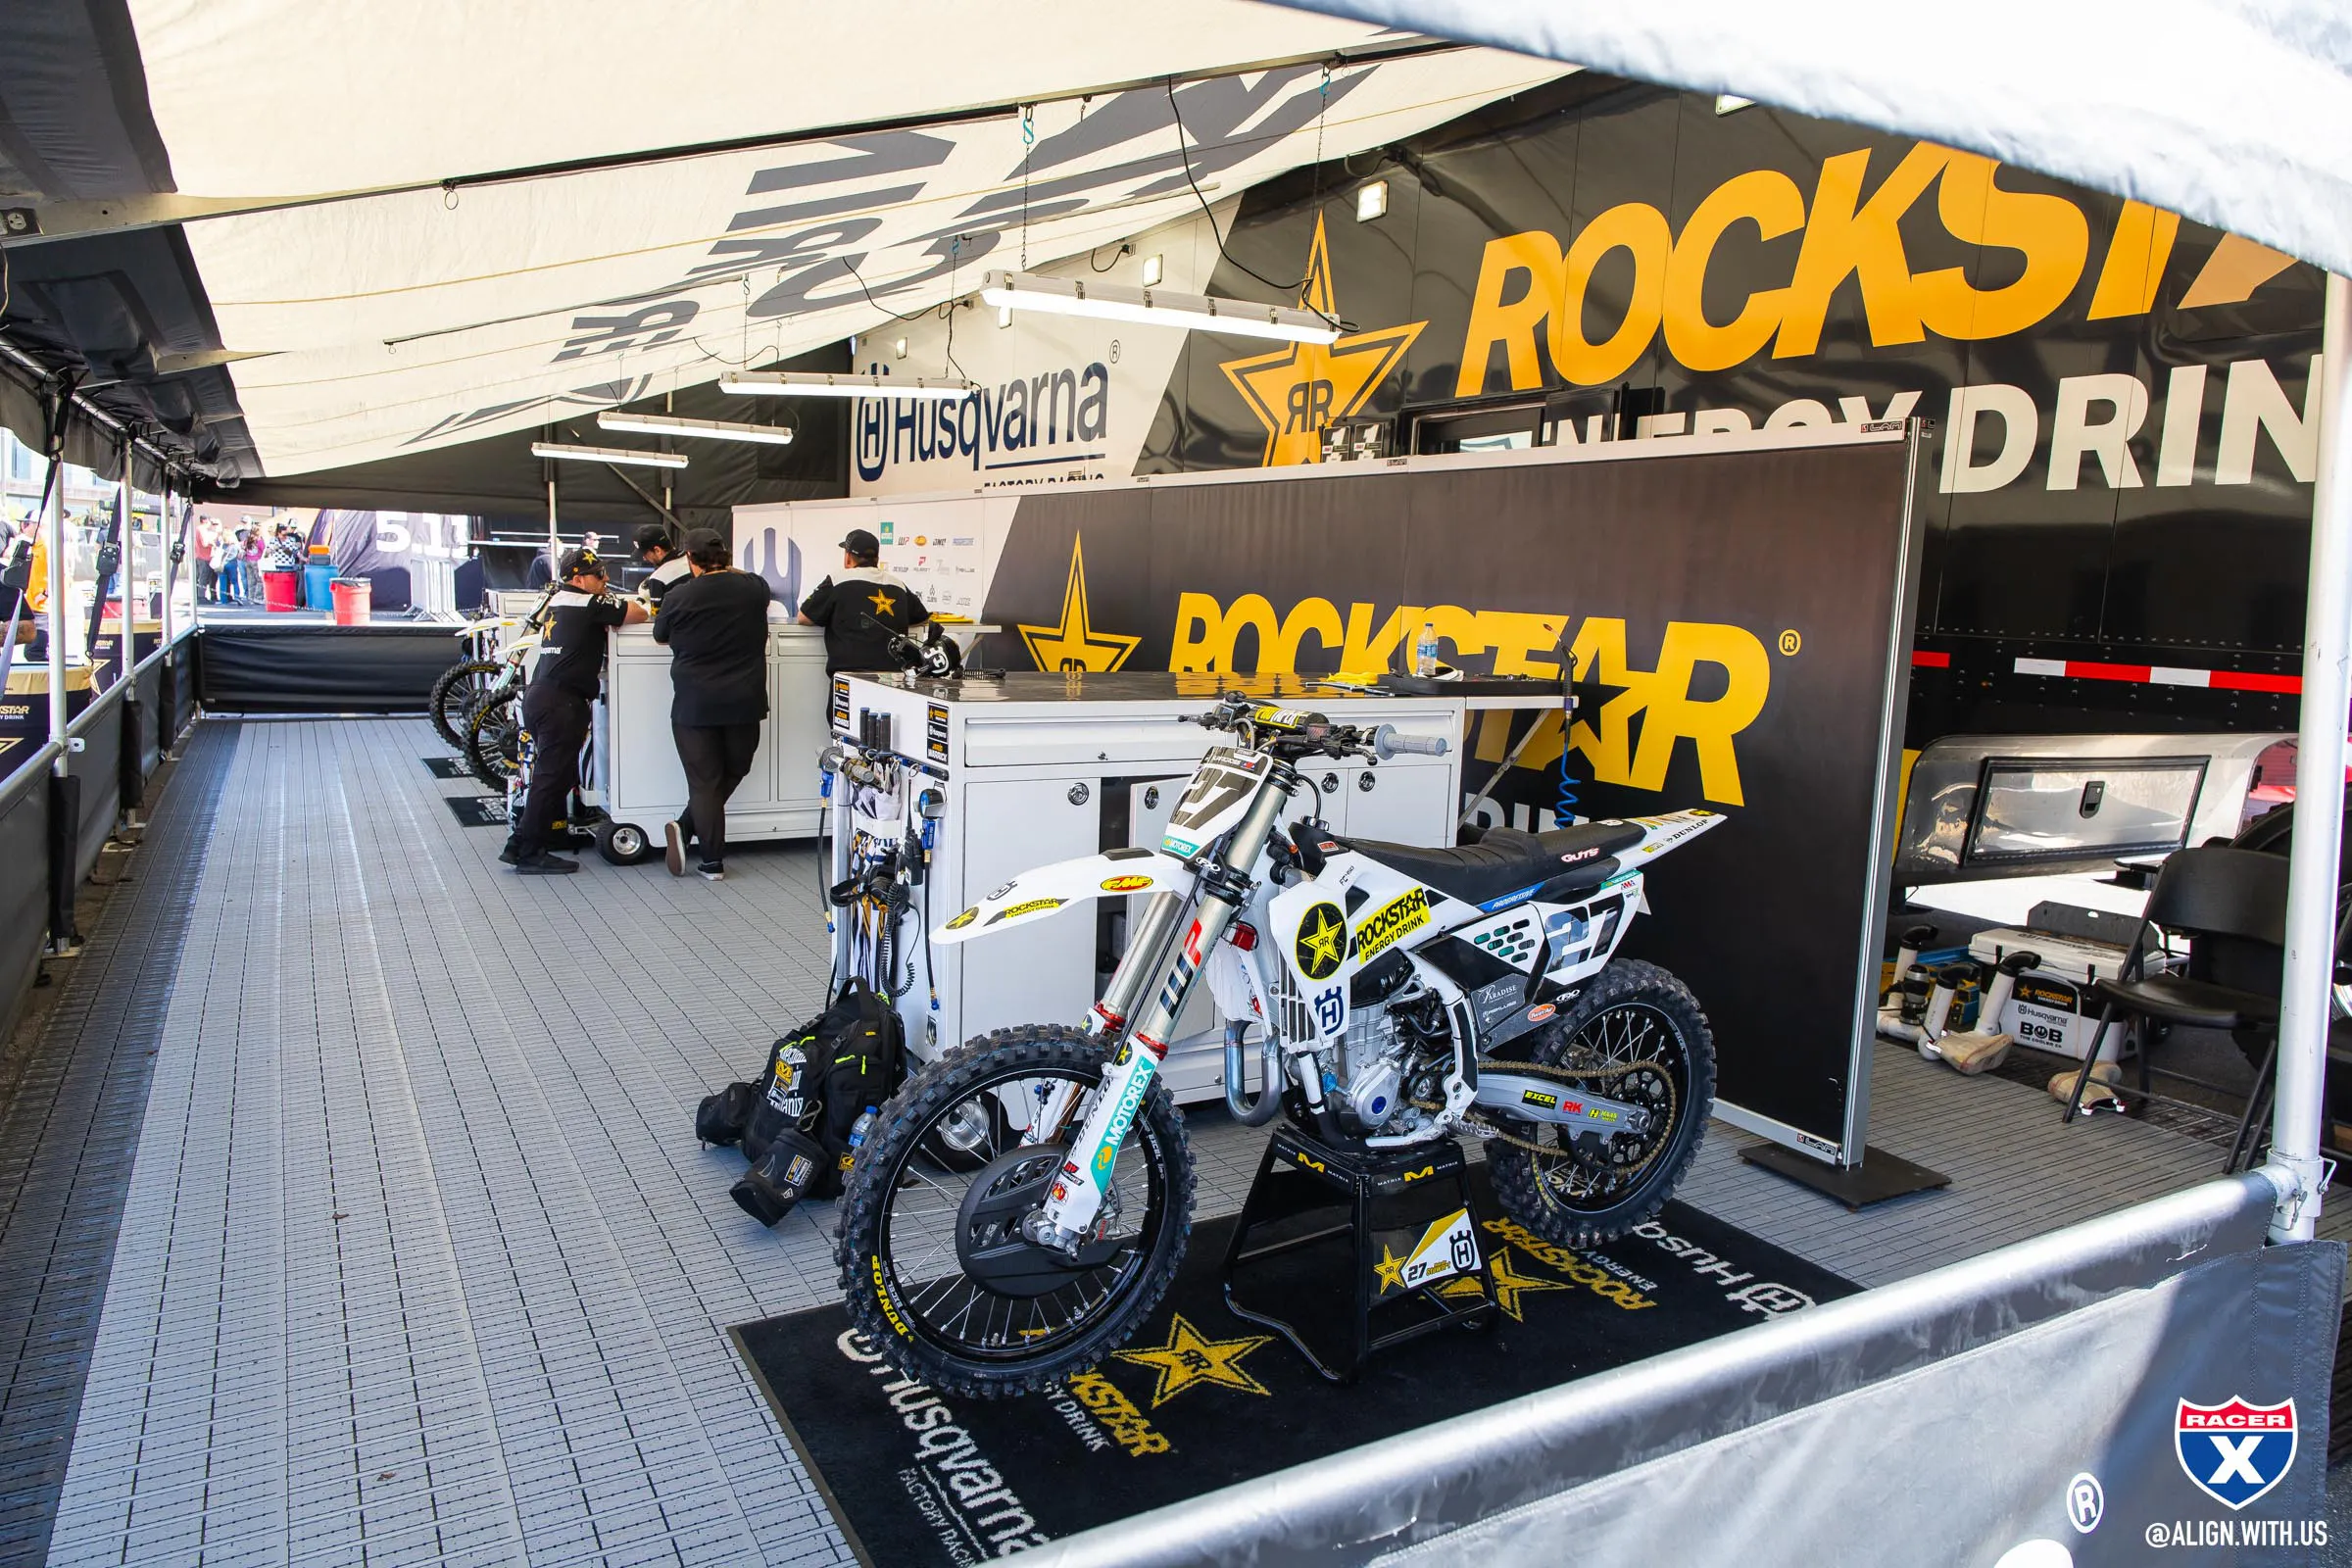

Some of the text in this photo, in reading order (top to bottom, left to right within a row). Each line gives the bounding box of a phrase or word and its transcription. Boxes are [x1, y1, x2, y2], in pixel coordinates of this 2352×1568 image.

[1456, 140, 2300, 396] ROCKS
[894, 362, 1109, 471] Husqvarna
[1673, 819, 1708, 840] DUNLOP
[1561, 847, 1599, 863] GUTS
[1004, 898, 1057, 916] ROCKSTAR
[1357, 887, 1428, 951] ROCKSTAR
[1365, 913, 1424, 961] ENERGY DRINK
[2034, 989, 2073, 1004] ROCKSTAR
[2028, 1008, 2068, 1024] Husqvarna
[2020, 1021, 2063, 1044] BOB
[1104, 1064, 1152, 1146] MOTOREX
[1525, 1091, 1556, 1103] EXCEL
[1562, 1100, 1584, 1113] RK
[1078, 1078, 1113, 1144] DUNLO
[1327, 1169, 1349, 1183] MATRIX
[1377, 1177, 1401, 1187] MATRIX
[1437, 1160, 1458, 1170] MATRIX
[1407, 1261, 1427, 1282] 27
[871, 1254, 909, 1336] DUNLOP
[1054, 1399, 1112, 1452] DRINK
[899, 1468, 951, 1529] FACTORY
